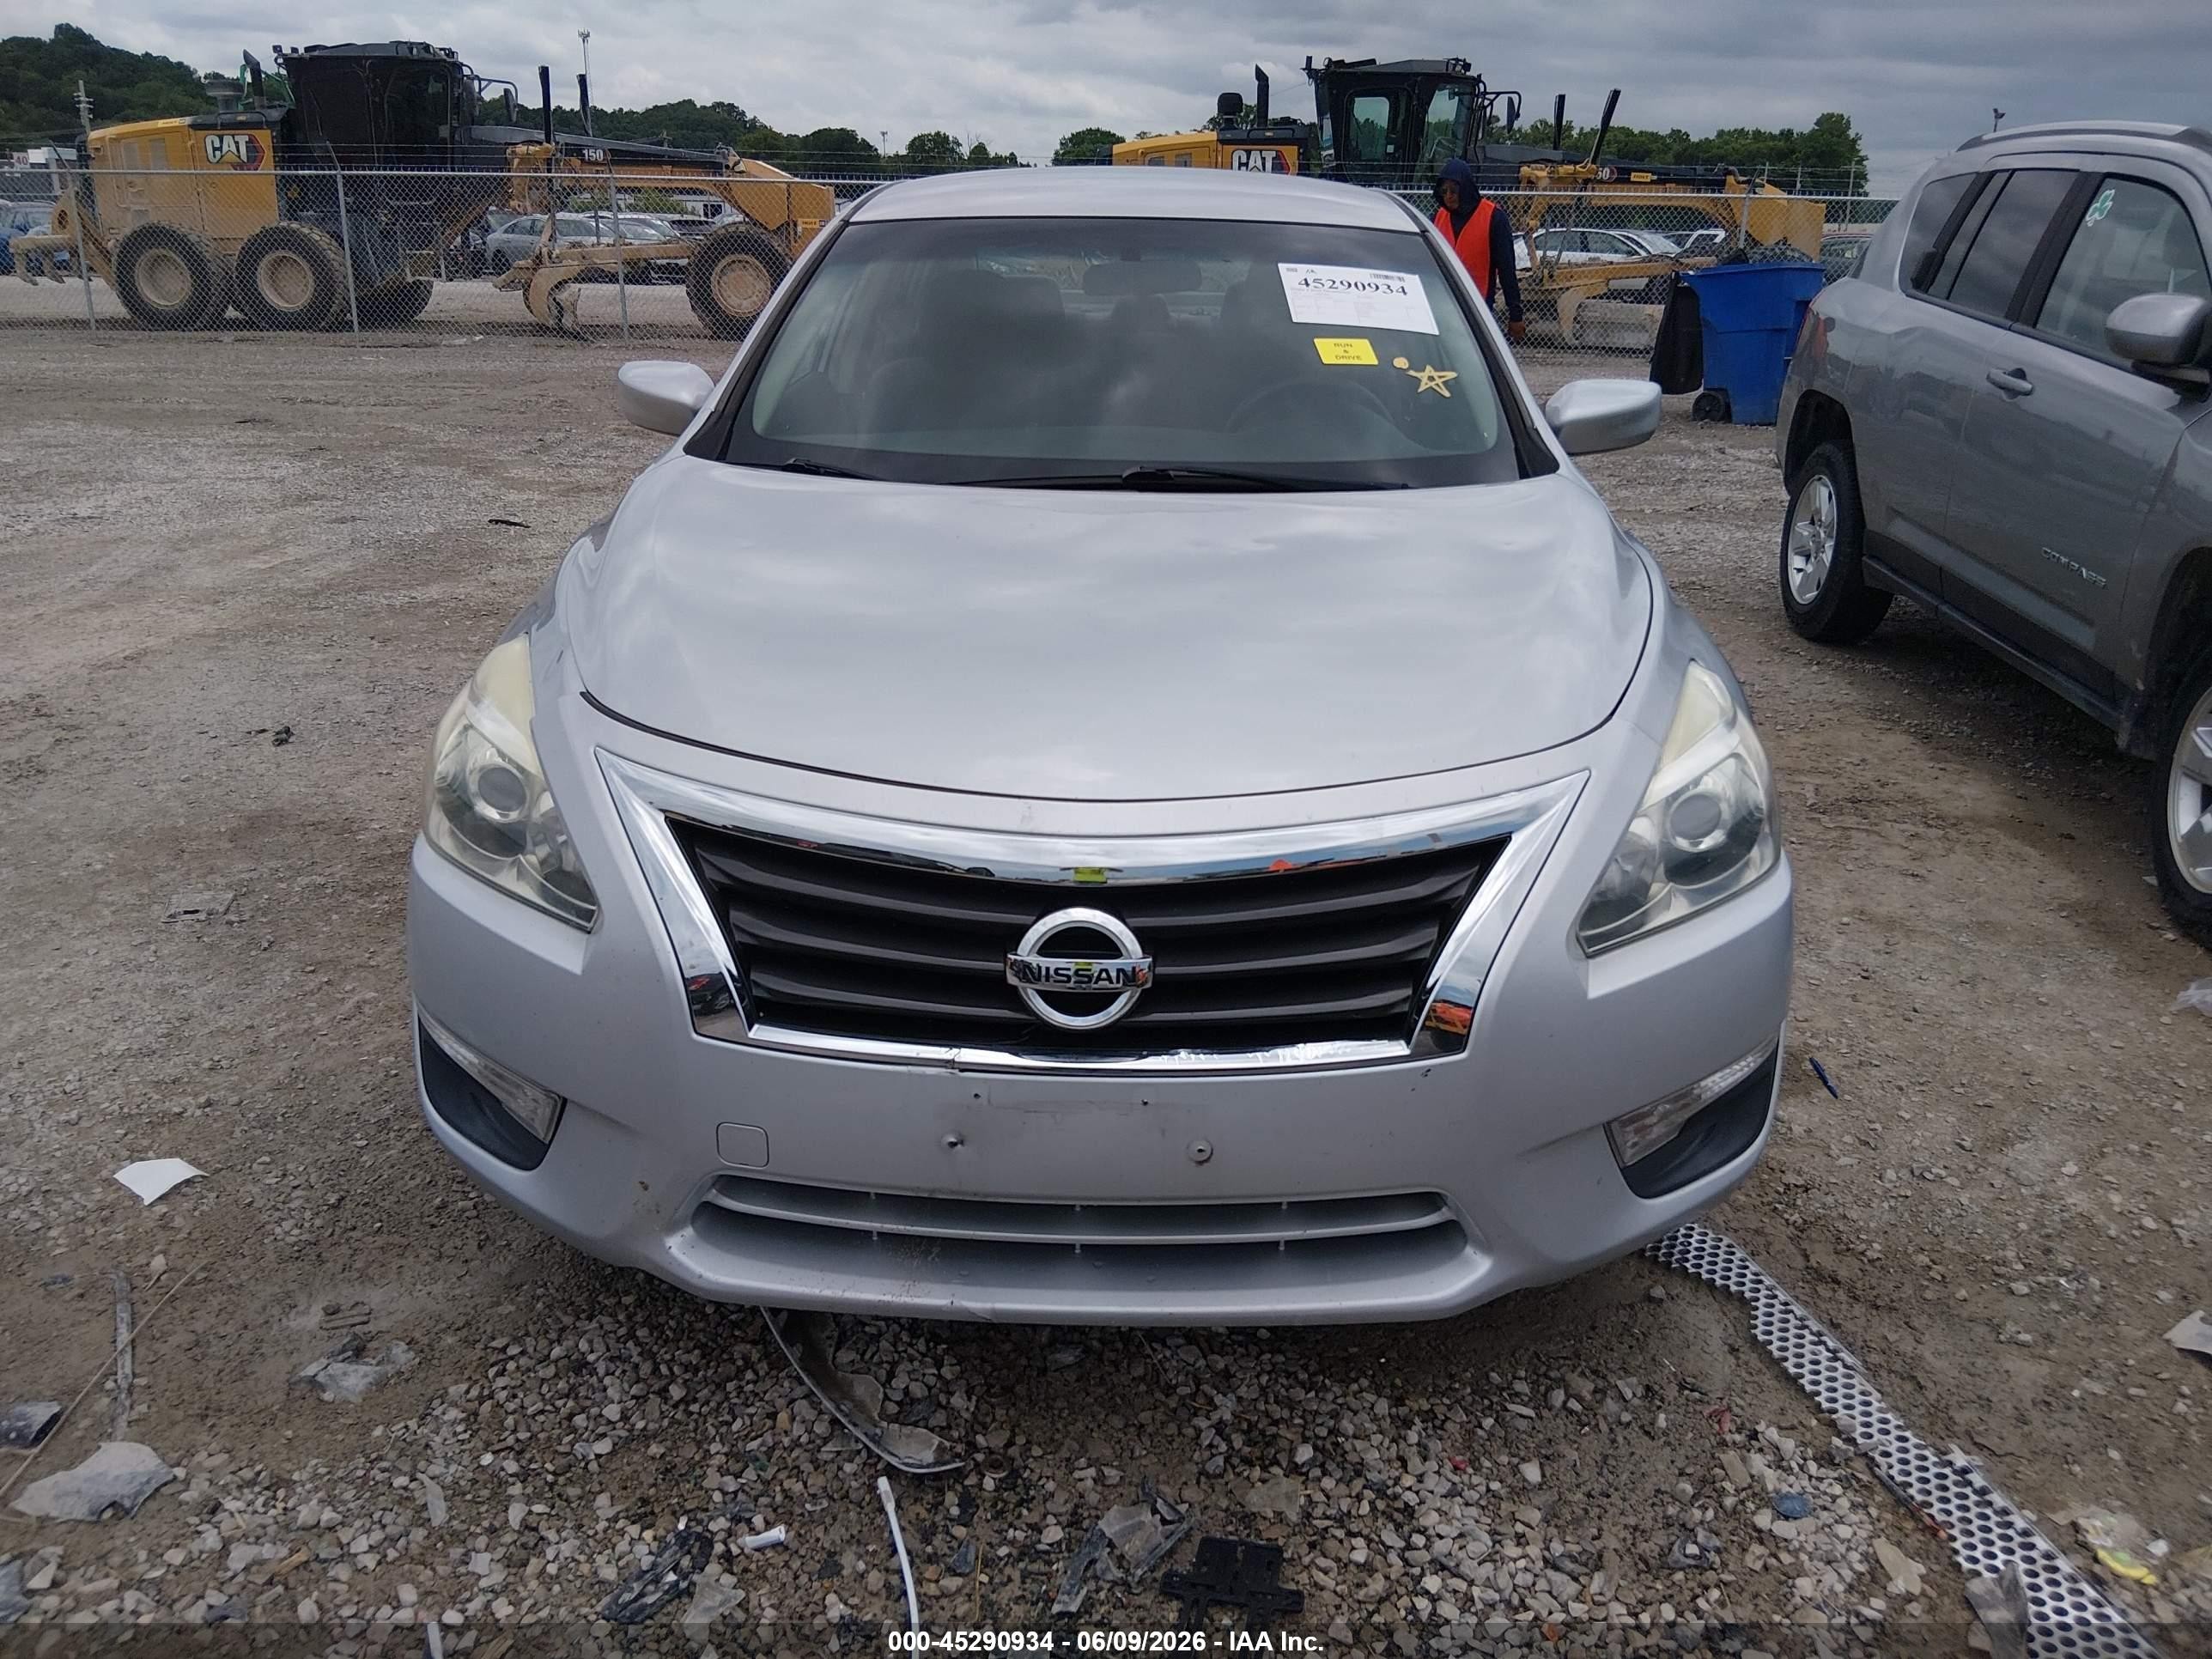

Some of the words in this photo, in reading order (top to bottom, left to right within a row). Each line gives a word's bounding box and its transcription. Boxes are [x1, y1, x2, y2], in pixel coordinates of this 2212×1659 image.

[205, 134, 249, 163] CAT
[582, 149, 604, 162] 150
[1232, 149, 1277, 173] CAT
[1297, 276, 1408, 296] 45290934
[1022, 962, 1138, 987] NISSAN
